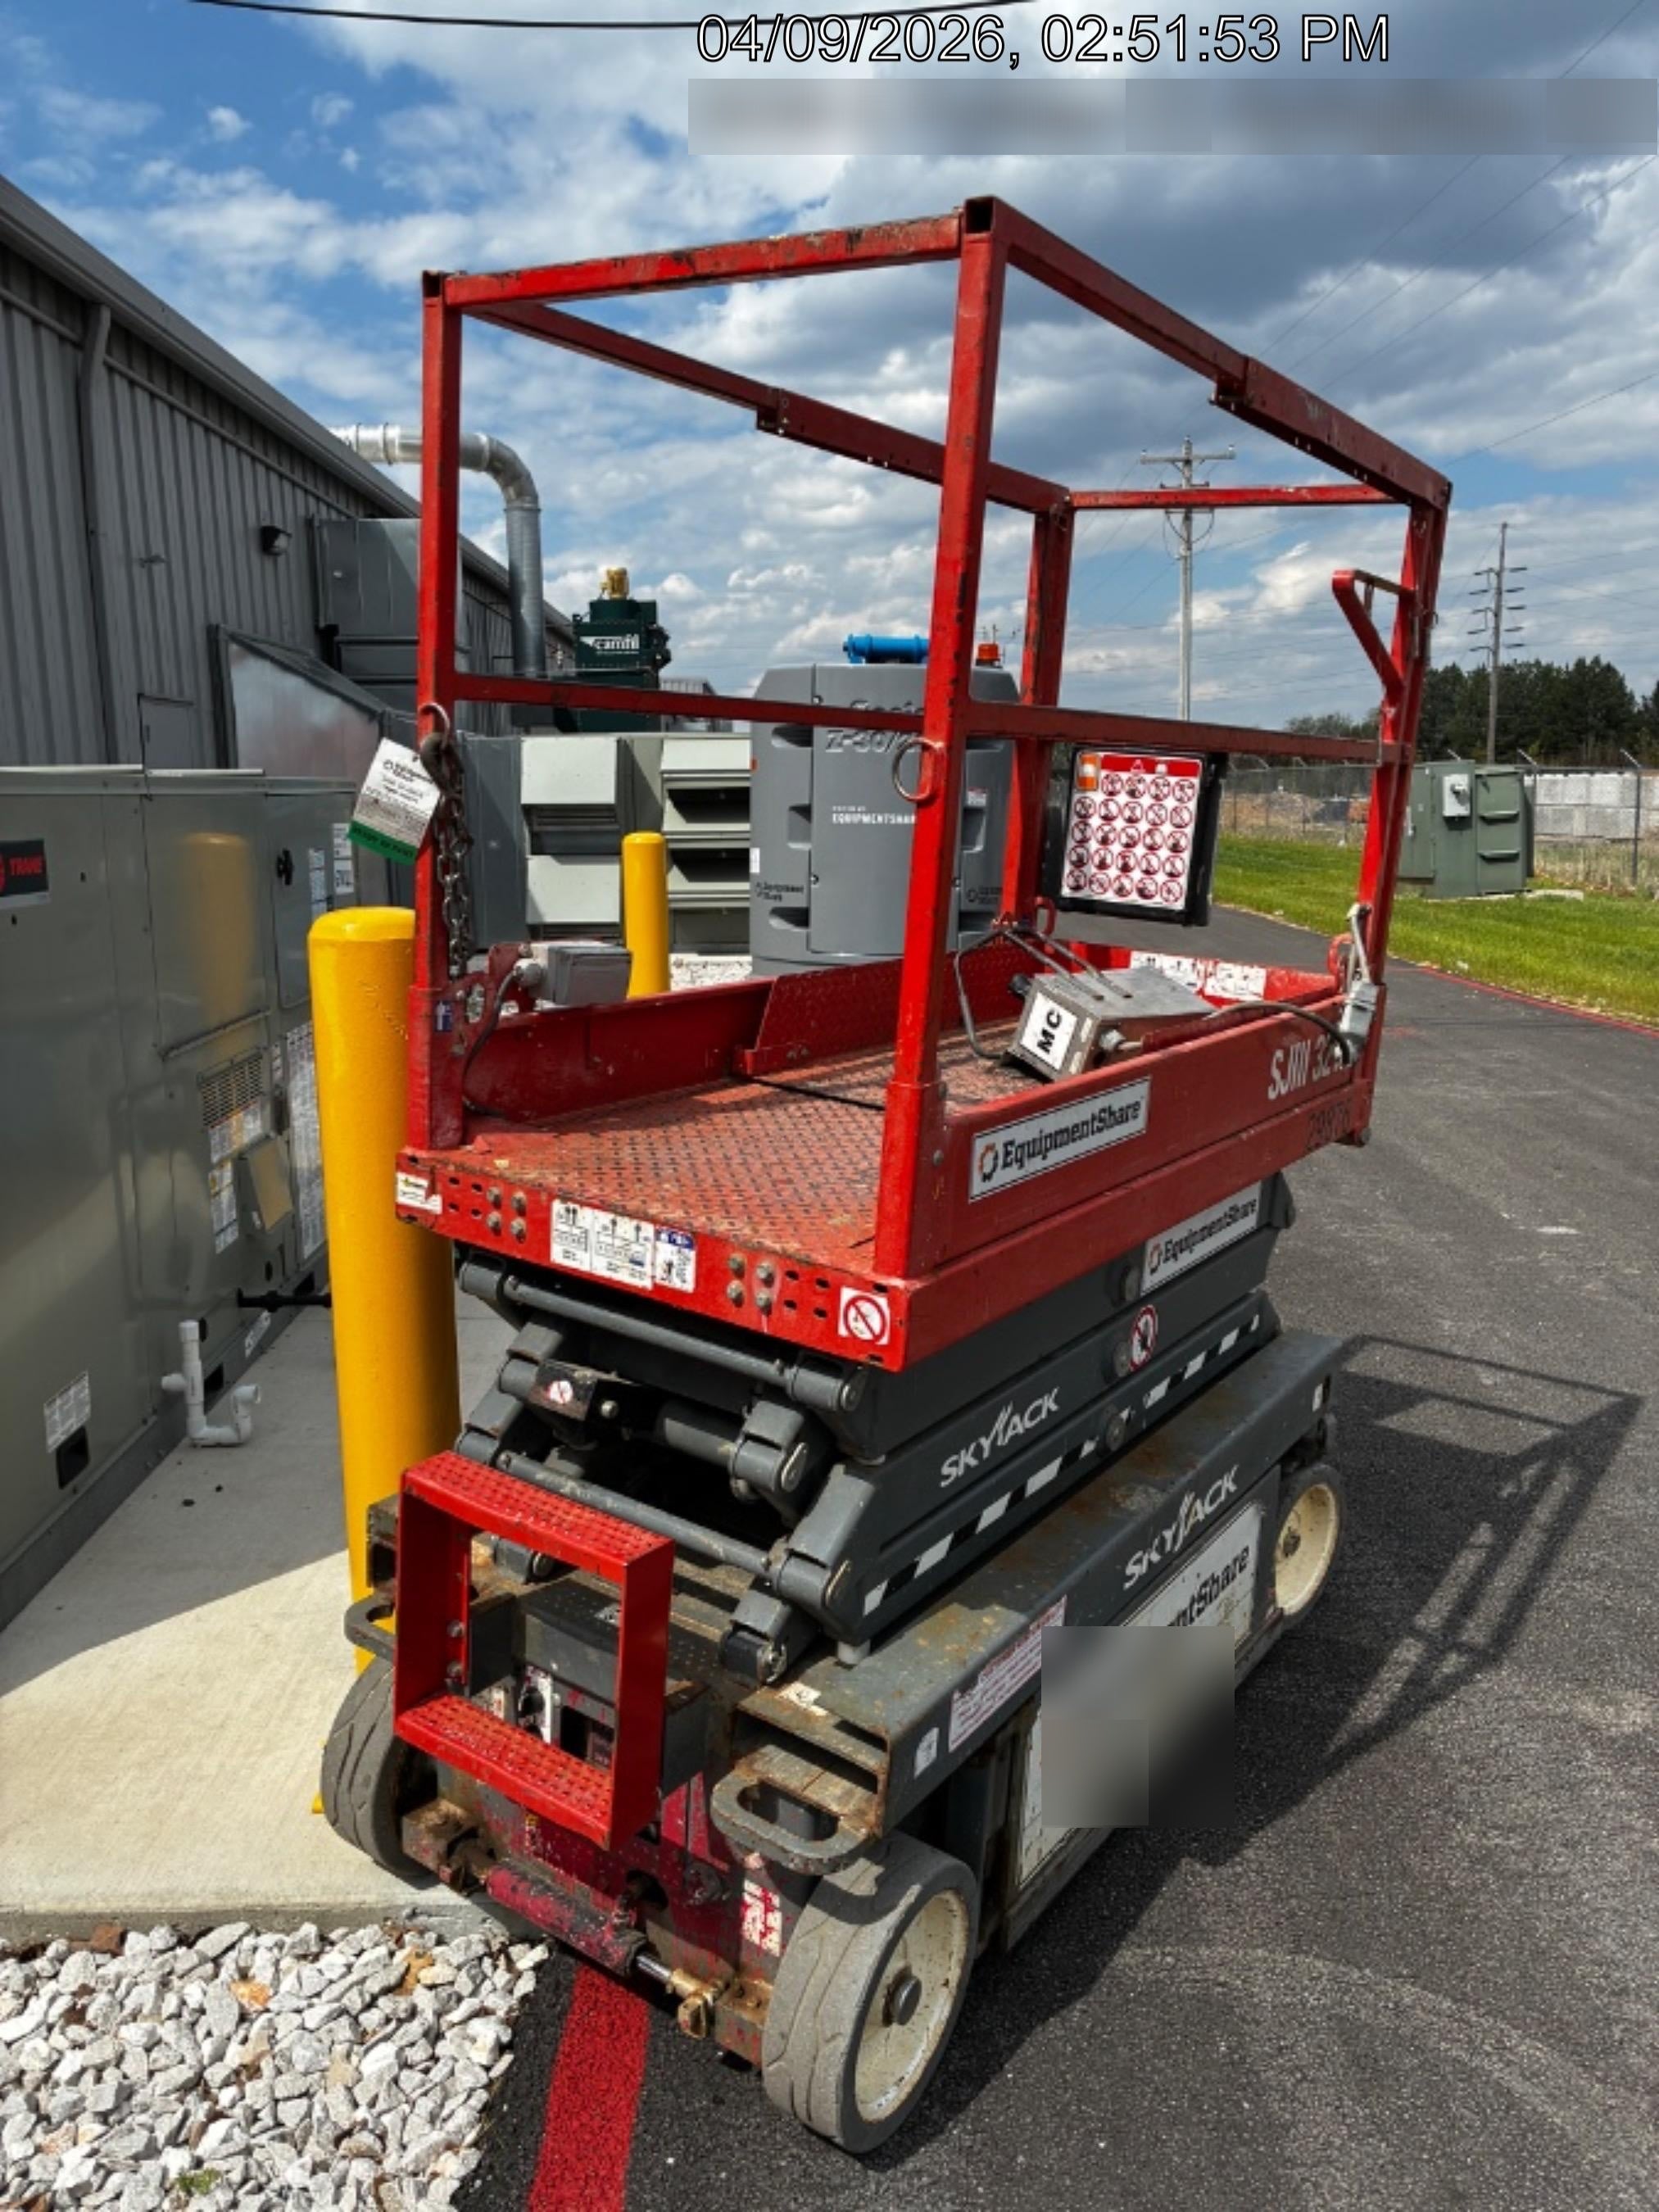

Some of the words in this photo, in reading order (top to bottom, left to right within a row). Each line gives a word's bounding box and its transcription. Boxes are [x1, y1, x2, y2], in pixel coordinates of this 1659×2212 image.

[1036, 1009, 1063, 1054] MC
[1001, 1100, 1141, 1170] EquipmentShare
[1163, 1199, 1257, 1263] EquipmentShare
[940, 1386, 1060, 1488] SKYJACK
[1122, 1464, 1240, 1591] SKYJACK
